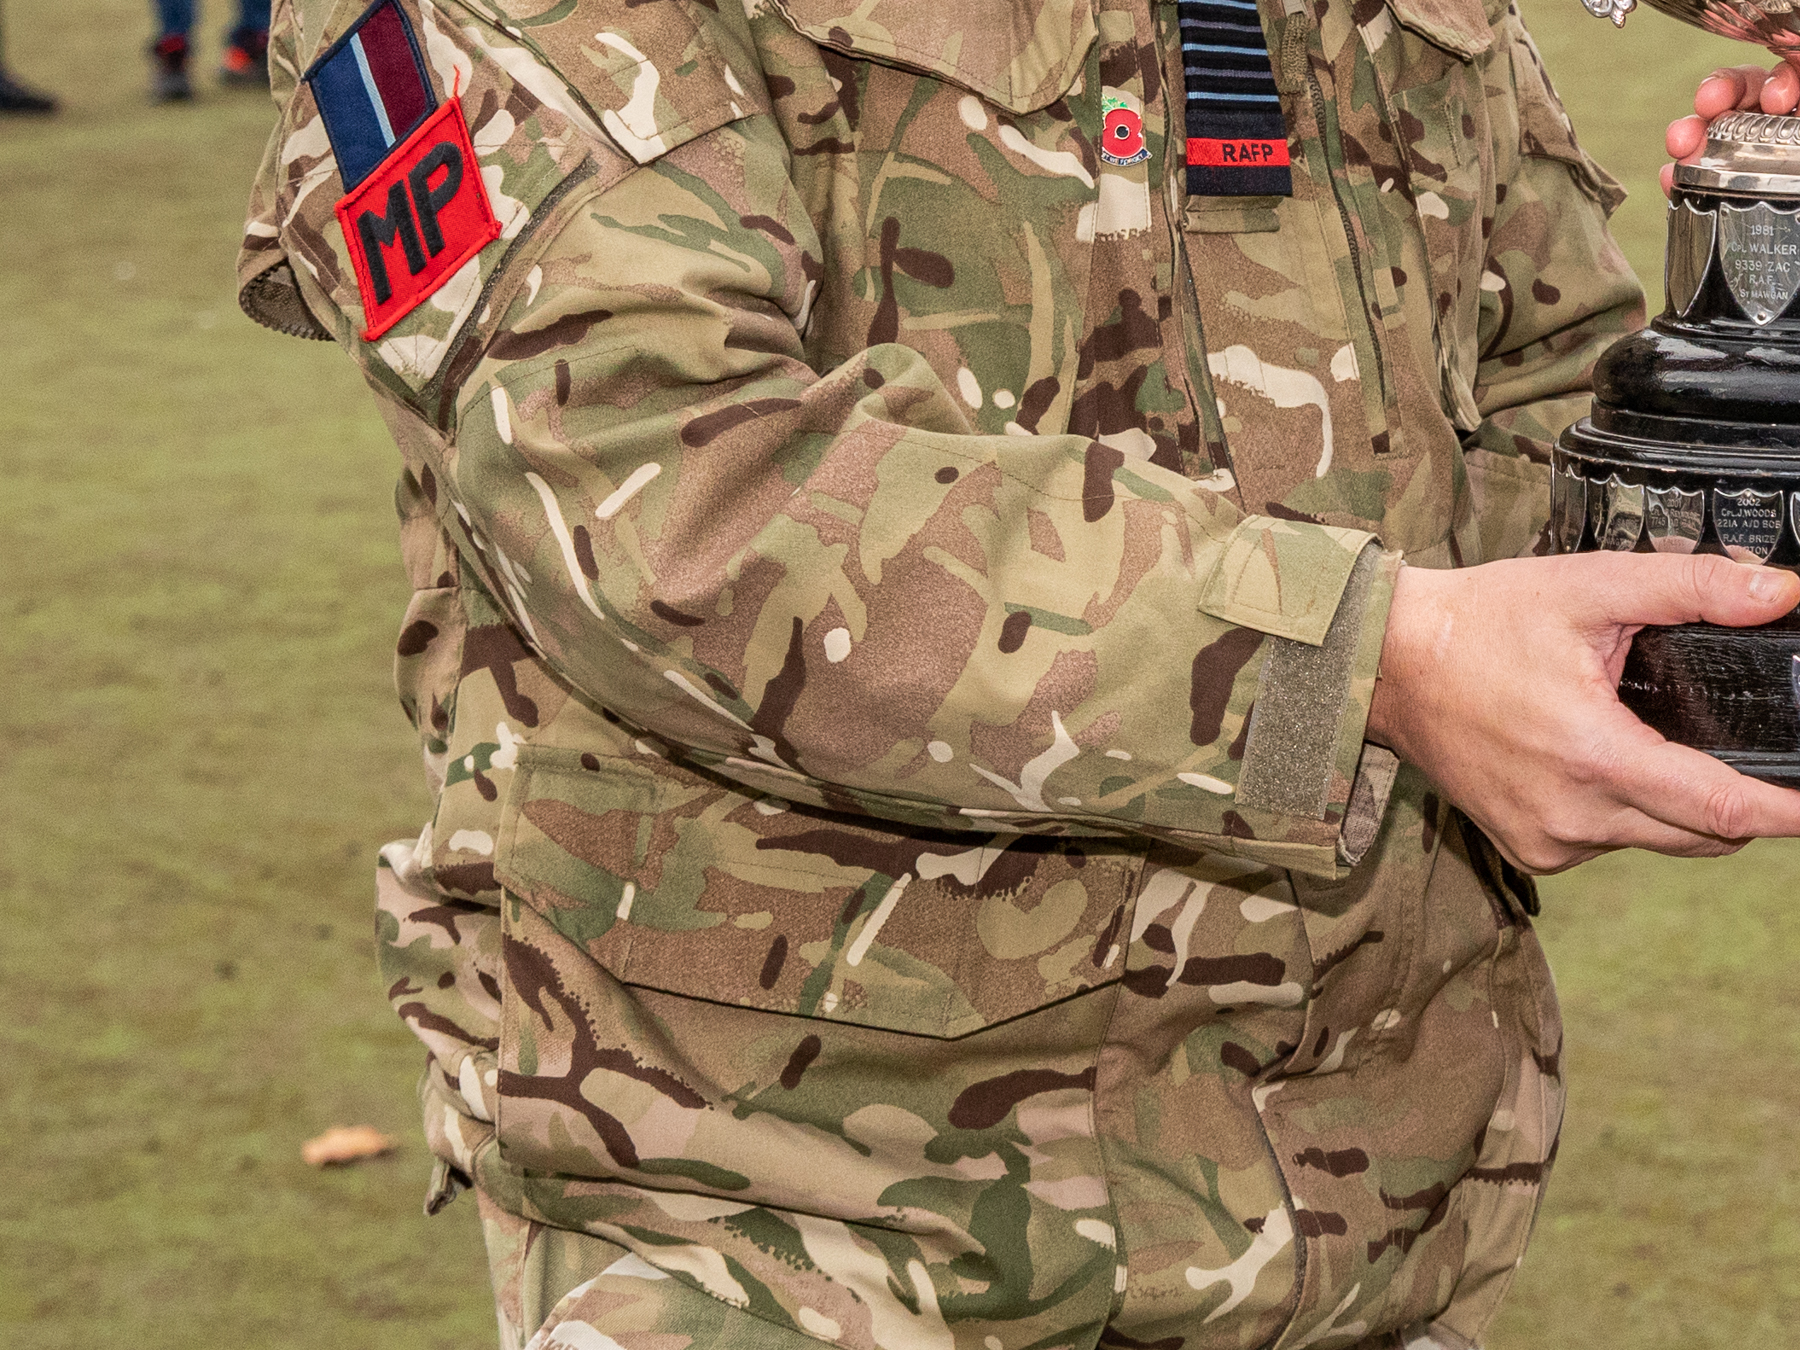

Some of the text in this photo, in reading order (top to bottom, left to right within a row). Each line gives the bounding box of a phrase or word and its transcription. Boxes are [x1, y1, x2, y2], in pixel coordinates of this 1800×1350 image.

[1222, 143, 1273, 162] RAFP
[356, 141, 464, 305] MP
[1750, 225, 1774, 236] 1981
[1749, 243, 1797, 255] WALKER
[1735, 260, 1791, 273] 9339 ZAC
[1751, 290, 1789, 300] MAWGAN
[1737, 499, 1761, 507] 2002
[1762, 520, 1781, 529] BOB
[1749, 535, 1776, 544] BRIZE
